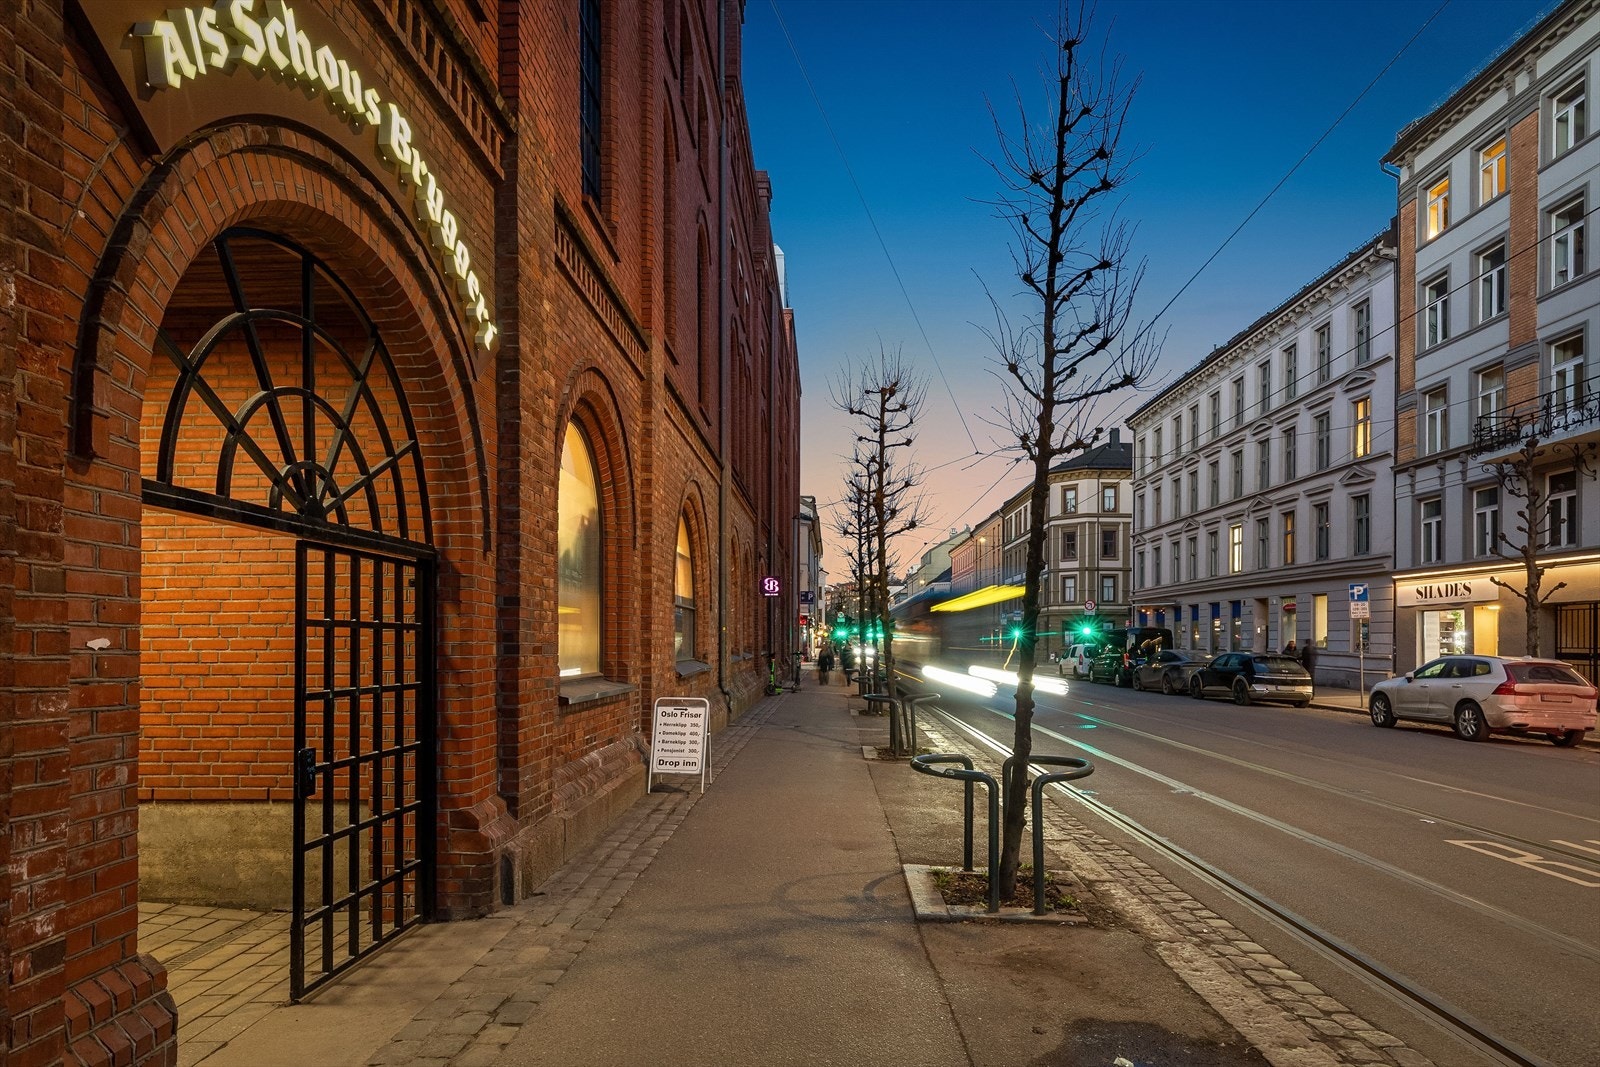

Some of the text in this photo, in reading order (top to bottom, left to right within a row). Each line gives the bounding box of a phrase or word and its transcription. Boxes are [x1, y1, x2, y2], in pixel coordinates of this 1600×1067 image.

[230, 0, 381, 126] Schous
[389, 103, 498, 351] Bryggeri
[1416, 581, 1472, 600] SHADES
[680, 711, 702, 719] Frisør
[658, 759, 680, 768] Drop
